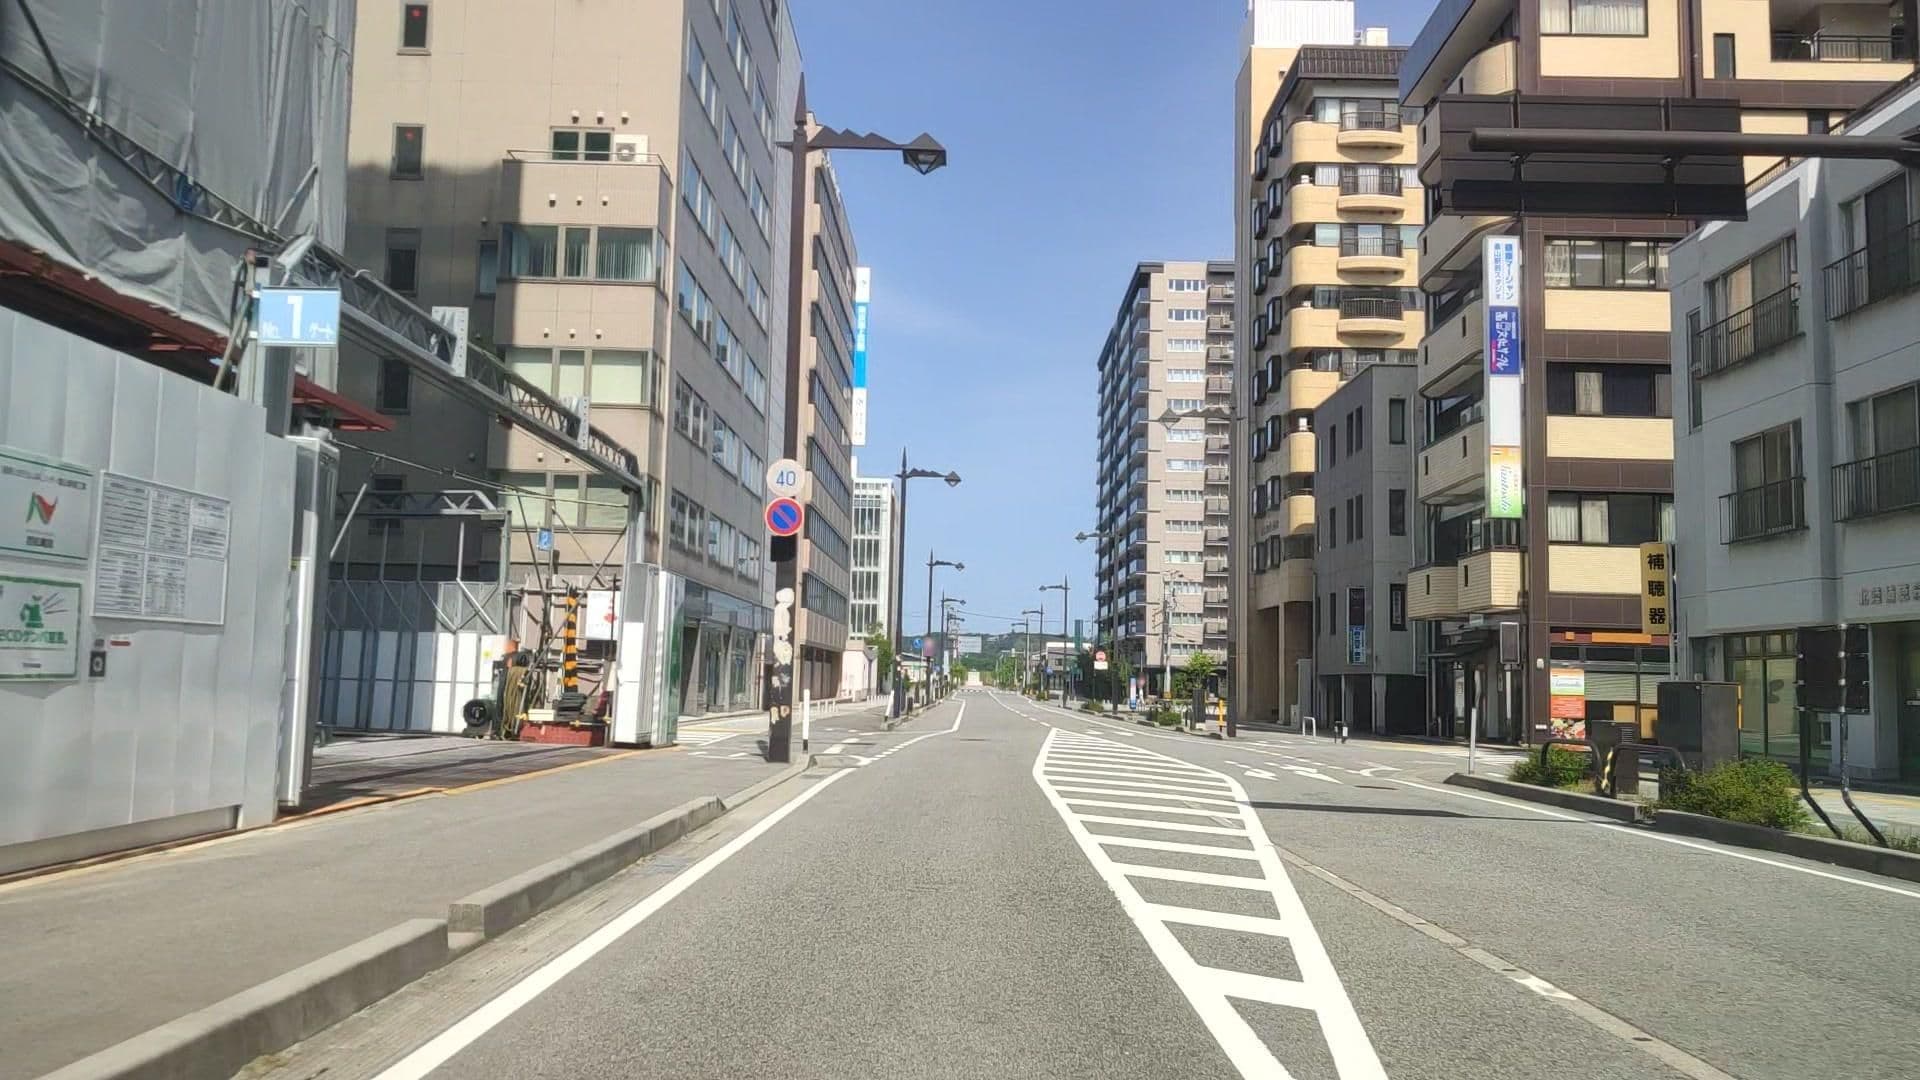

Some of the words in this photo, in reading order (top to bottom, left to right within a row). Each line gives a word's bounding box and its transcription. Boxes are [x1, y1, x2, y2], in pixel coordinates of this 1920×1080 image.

[287, 295, 303, 339] 1
[775, 470, 797, 487] 40
[1646, 552, 1667, 625] 補聴器
